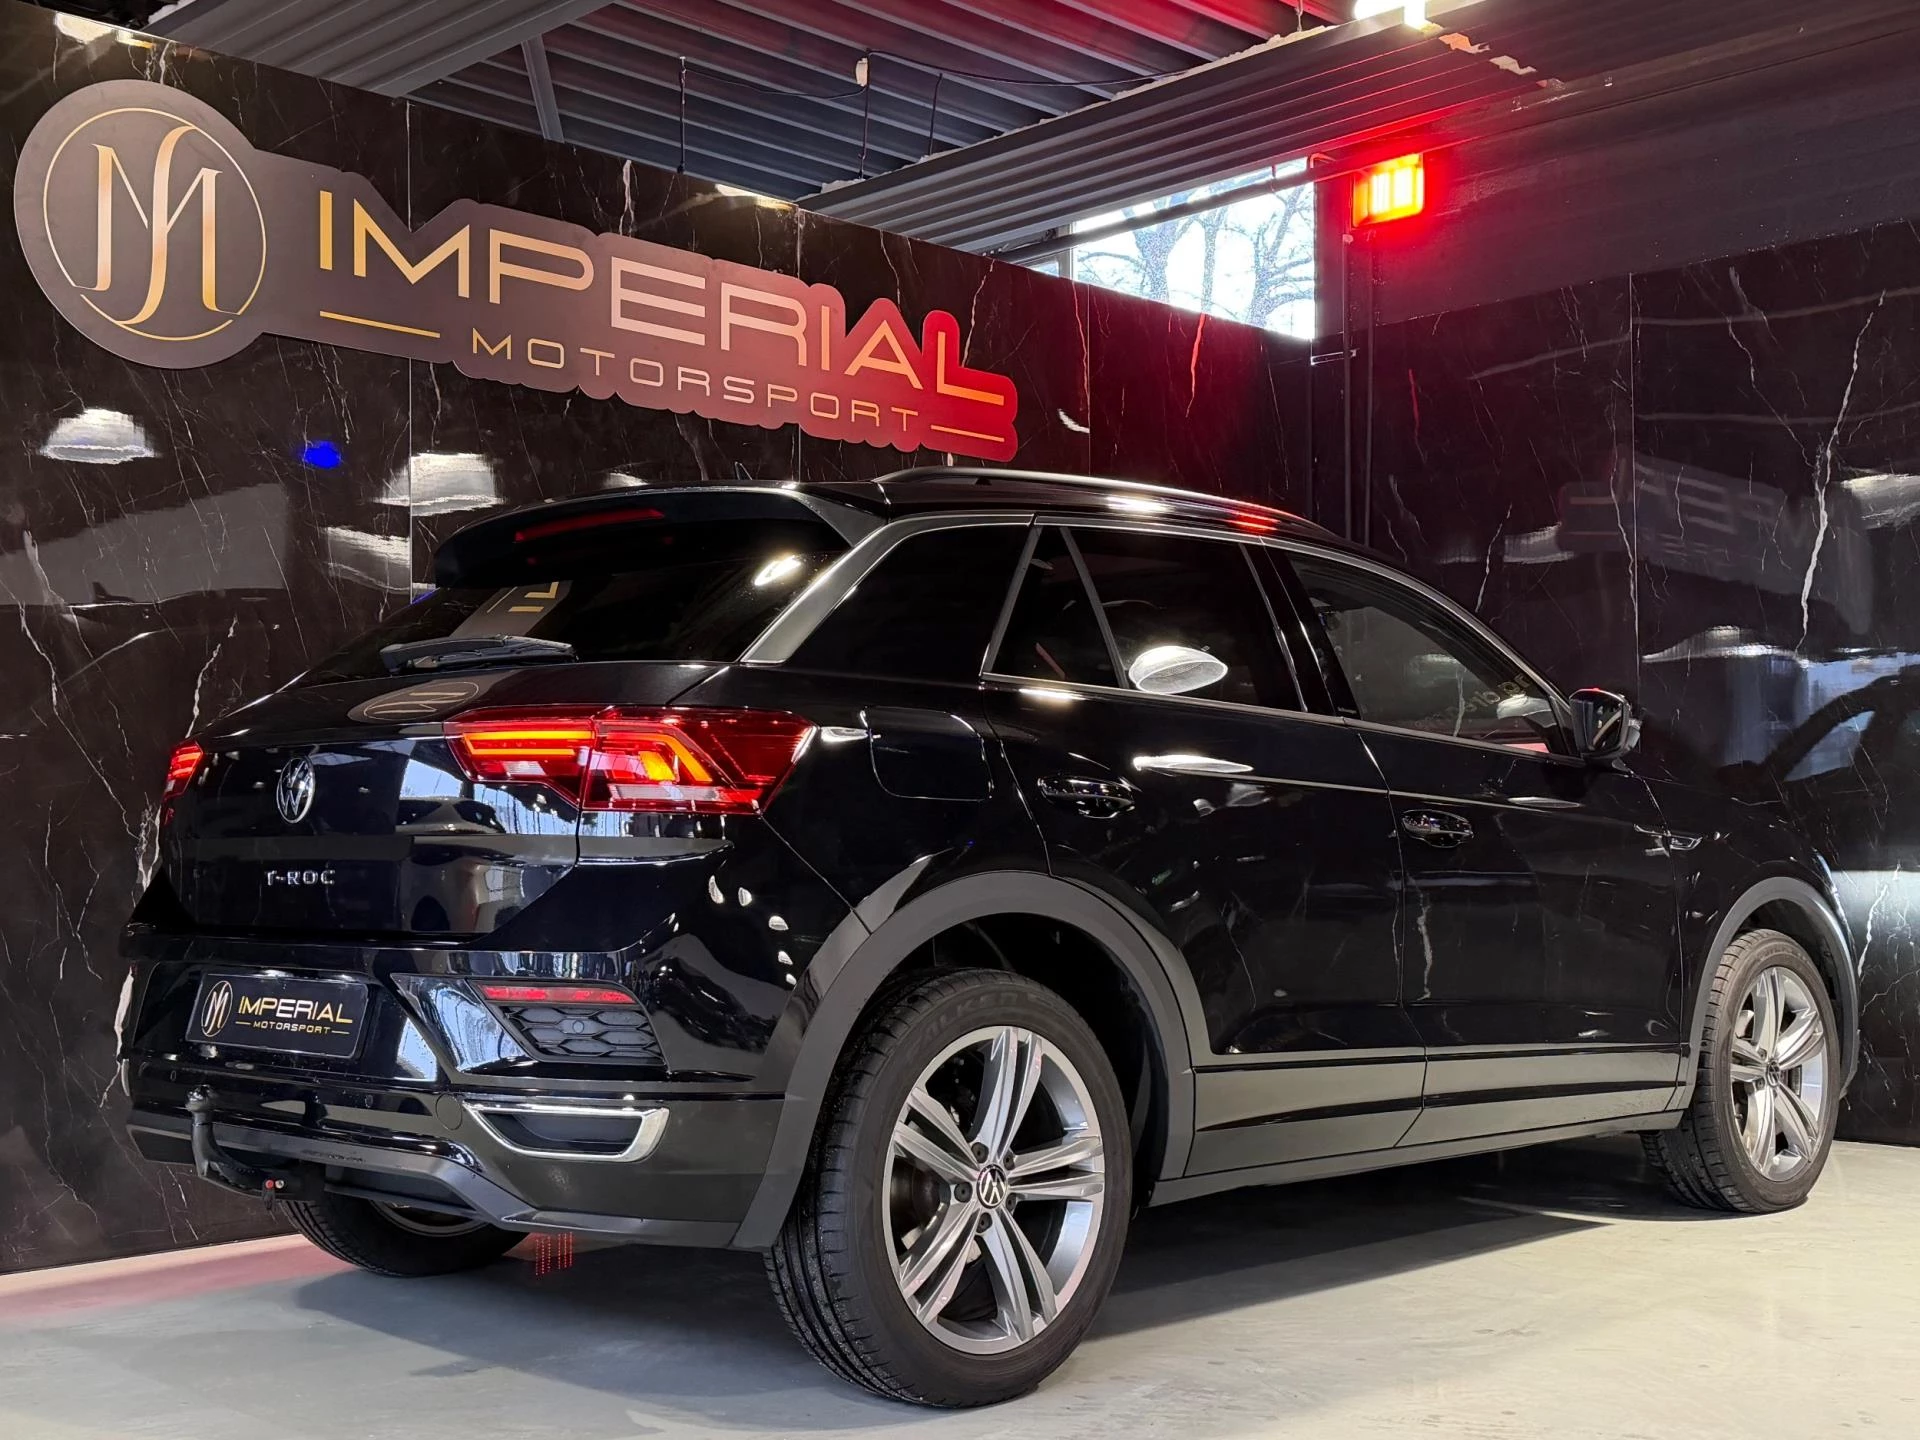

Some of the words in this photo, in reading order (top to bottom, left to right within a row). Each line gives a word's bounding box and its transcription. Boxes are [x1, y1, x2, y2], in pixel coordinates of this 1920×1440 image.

[320, 190, 1005, 406] IMPERIAL
[472, 327, 919, 432] MOTORSPORT
[264, 870, 335, 886] T-ROC
[238, 995, 353, 1024] IMPERIAL
[253, 1020, 331, 1034] MOTORSPORT
